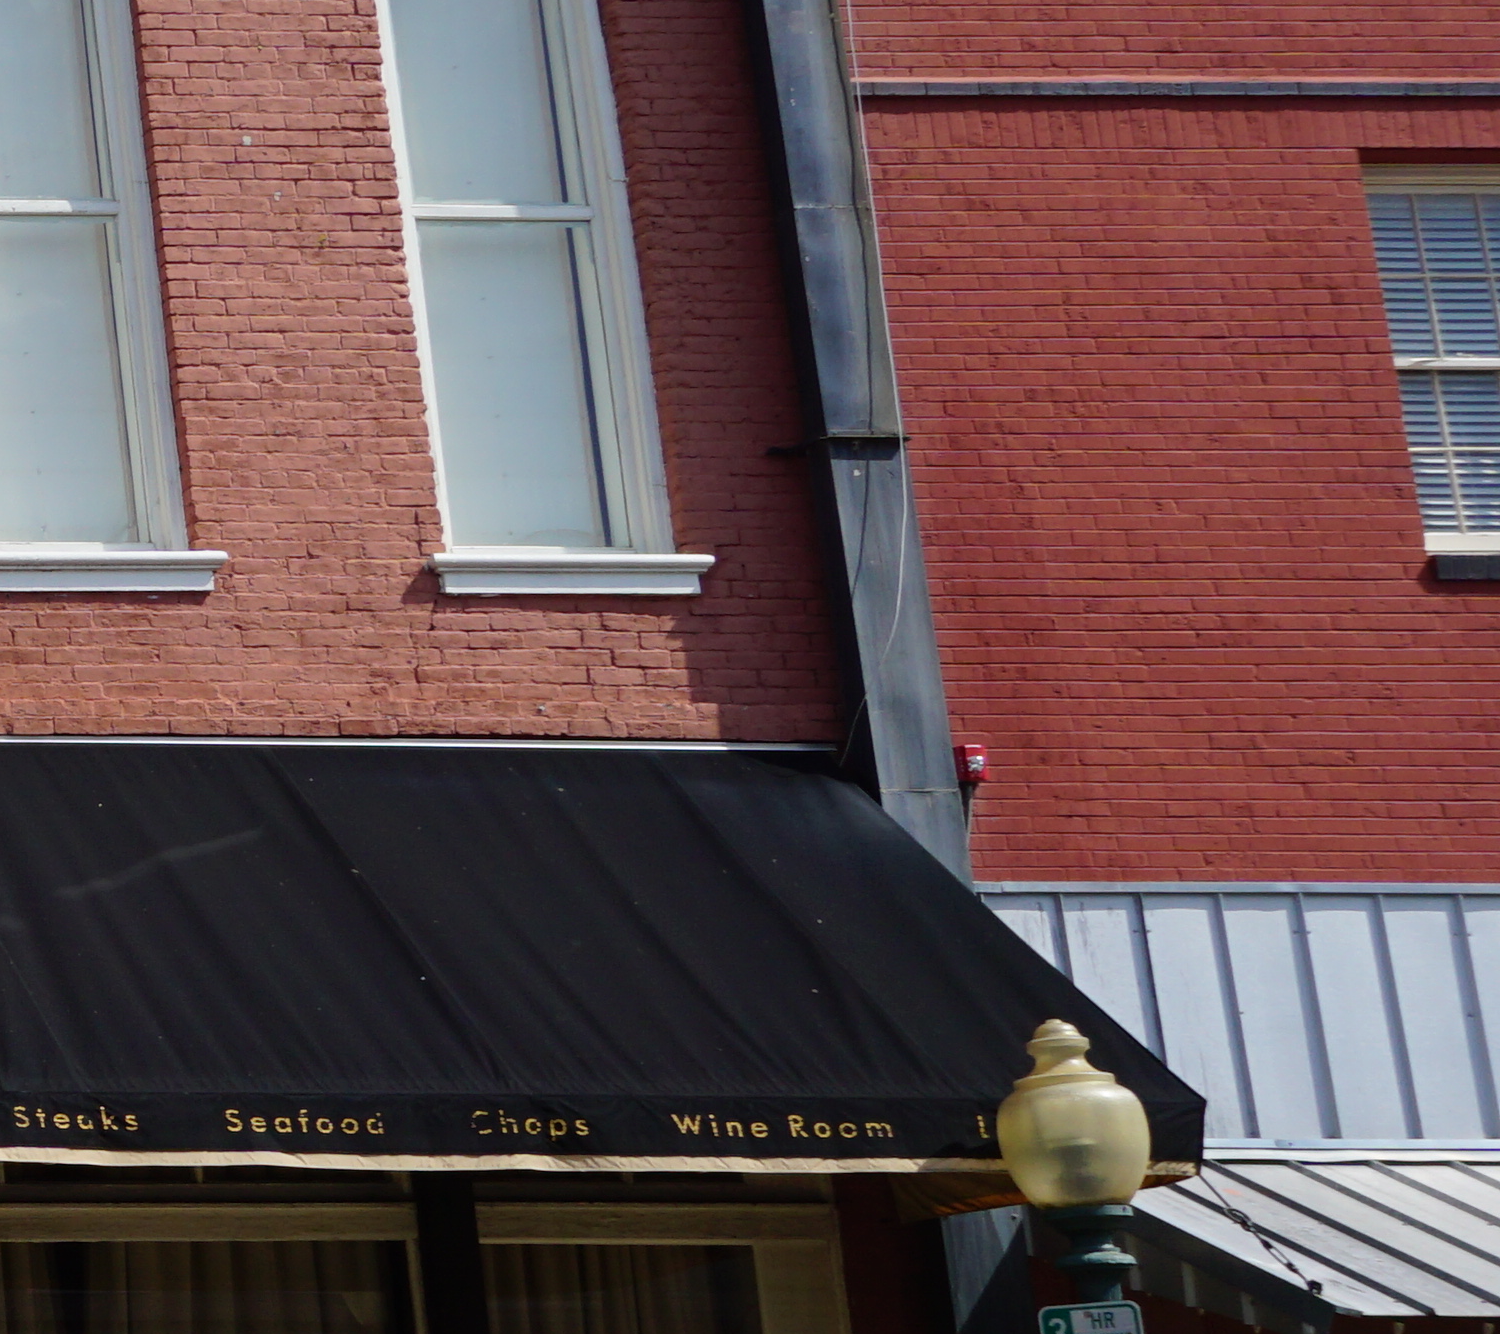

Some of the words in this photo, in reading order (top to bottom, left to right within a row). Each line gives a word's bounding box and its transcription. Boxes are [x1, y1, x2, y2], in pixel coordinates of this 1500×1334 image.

[13, 1105, 139, 1131] Steaks
[223, 1108, 385, 1134] Seafood
[470, 1110, 590, 1142] Chops
[671, 1113, 769, 1139] Wine
[788, 1114, 894, 1139] Room
[1091, 1311, 1115, 1329] HR
